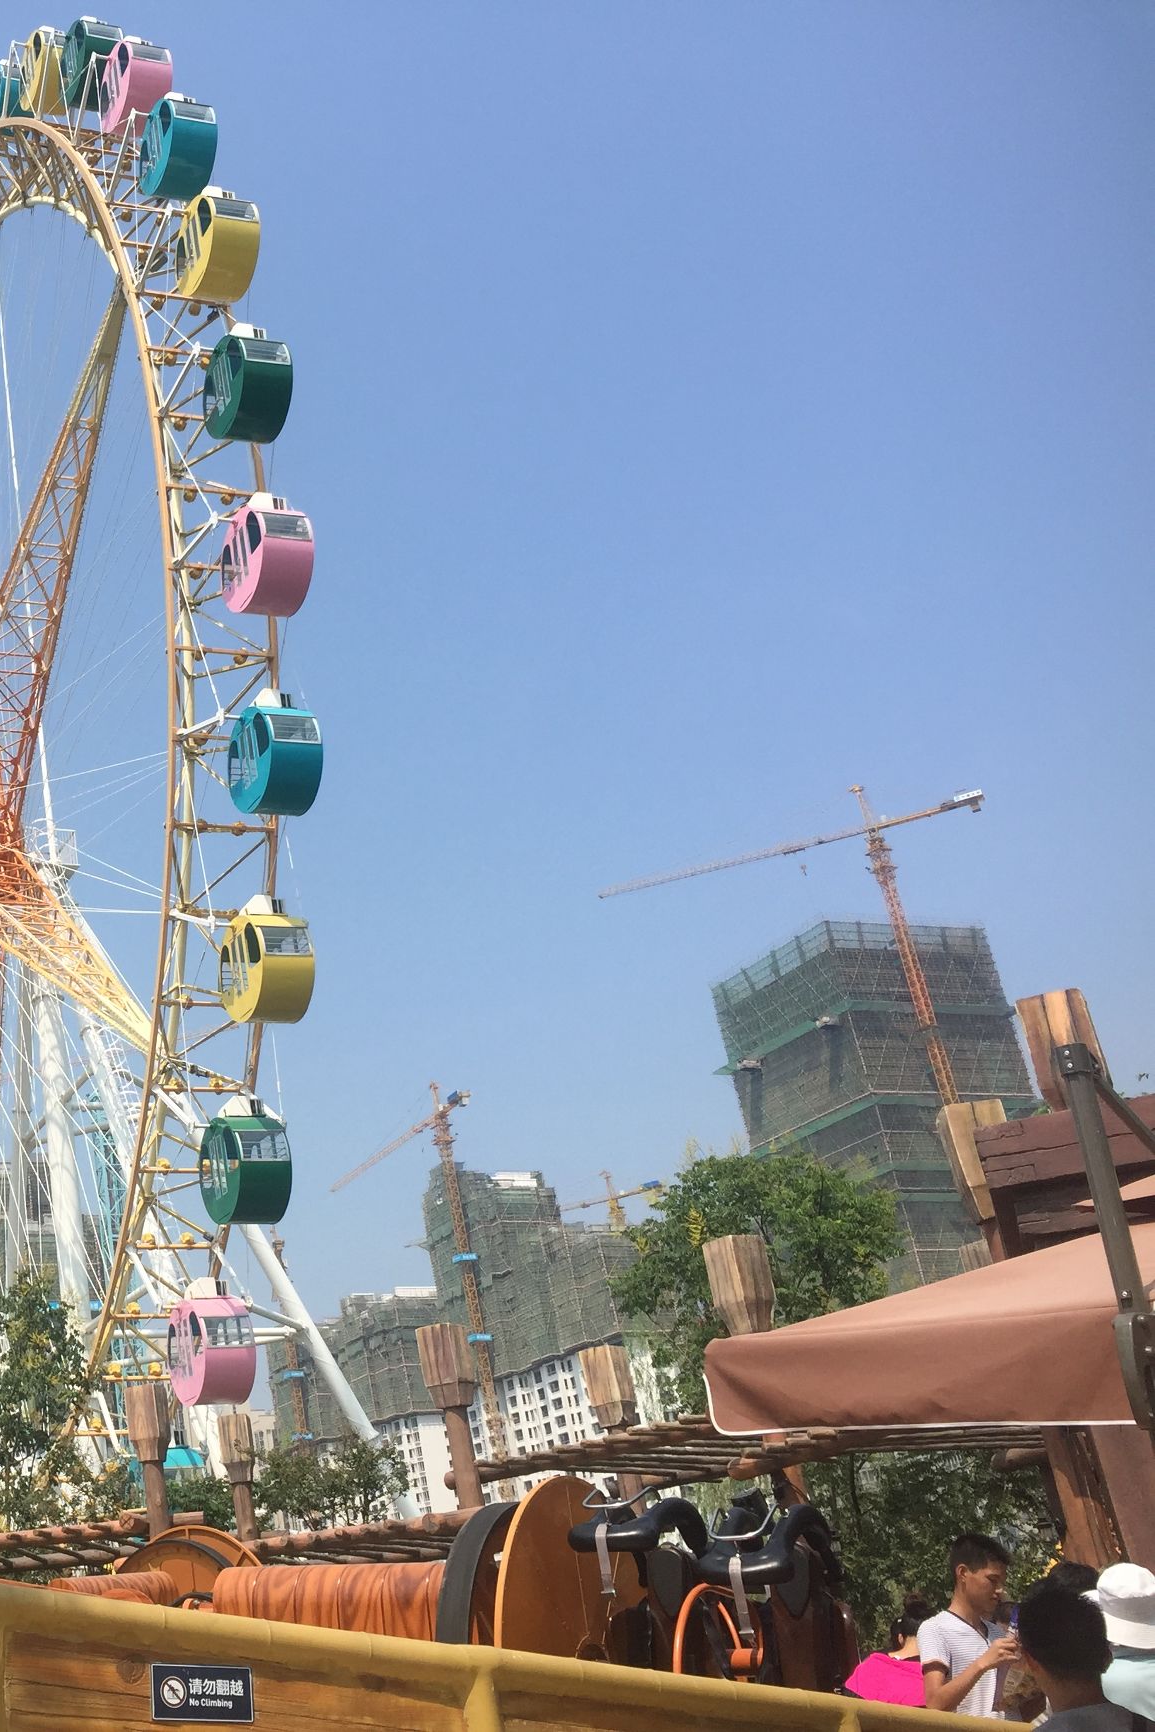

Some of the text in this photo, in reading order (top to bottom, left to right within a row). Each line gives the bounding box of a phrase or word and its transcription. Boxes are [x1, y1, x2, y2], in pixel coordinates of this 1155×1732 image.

[188, 1678, 244, 1696] 请勿翻越
[189, 1698, 233, 1709] No Climbing
